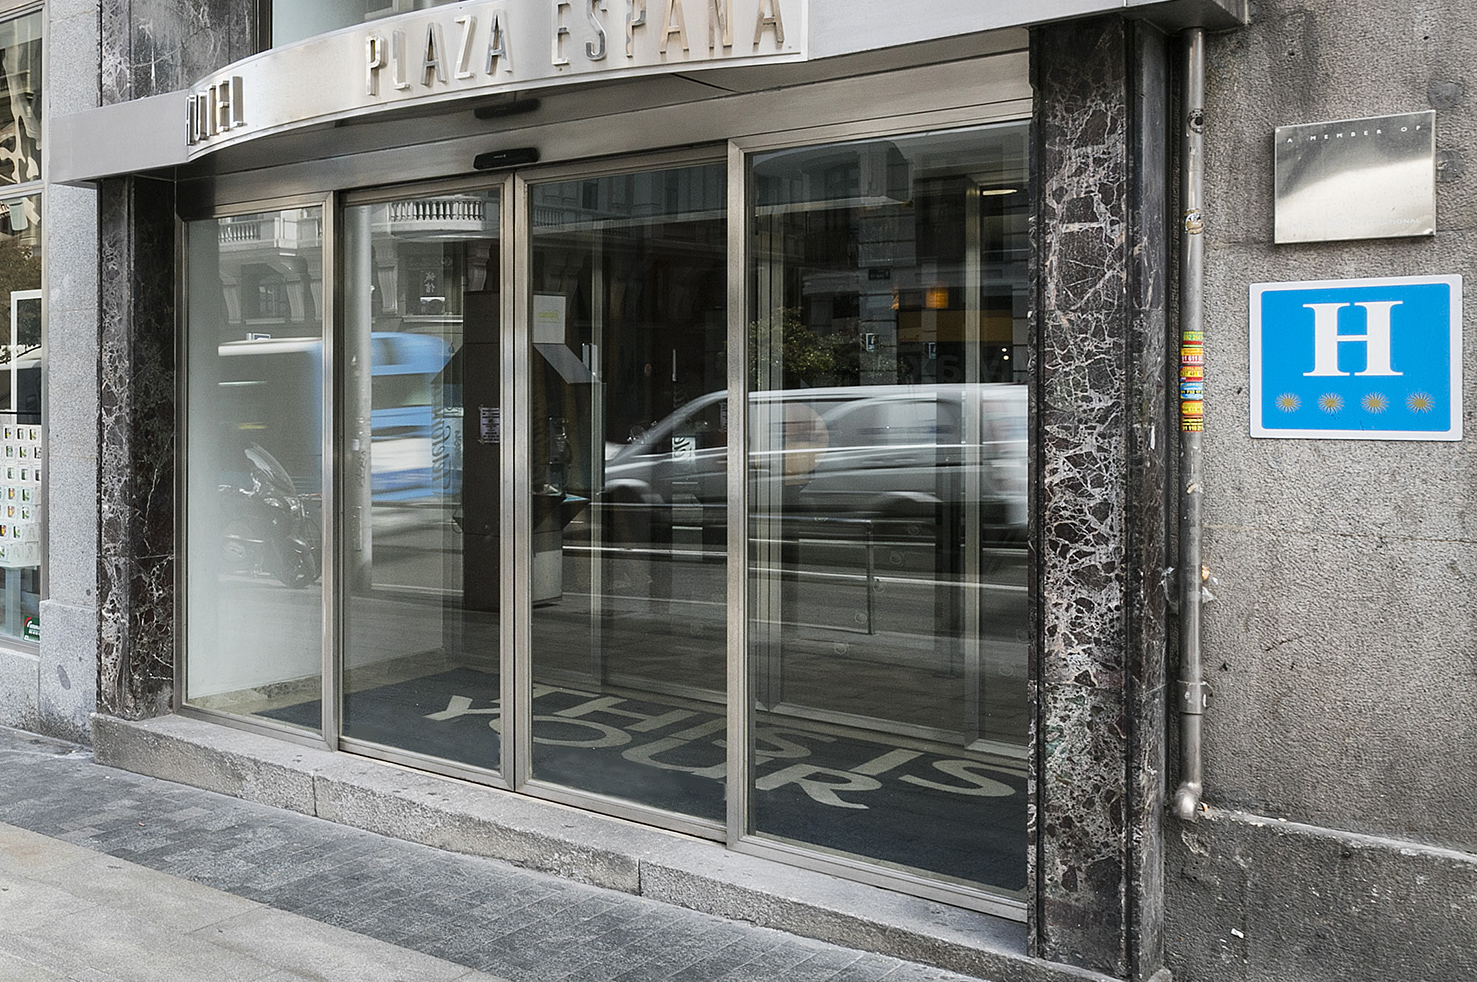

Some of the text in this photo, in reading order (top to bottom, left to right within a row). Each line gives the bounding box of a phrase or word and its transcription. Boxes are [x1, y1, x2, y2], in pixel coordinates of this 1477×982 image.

[186, 75, 245, 146] HOTEL
[365, 9, 514, 97] PLAZA
[1309, 128, 1383, 142] MEMBER
[1400, 124, 1422, 133] OF
[1303, 300, 1404, 377] H
[424, 694, 883, 810] YOUR
